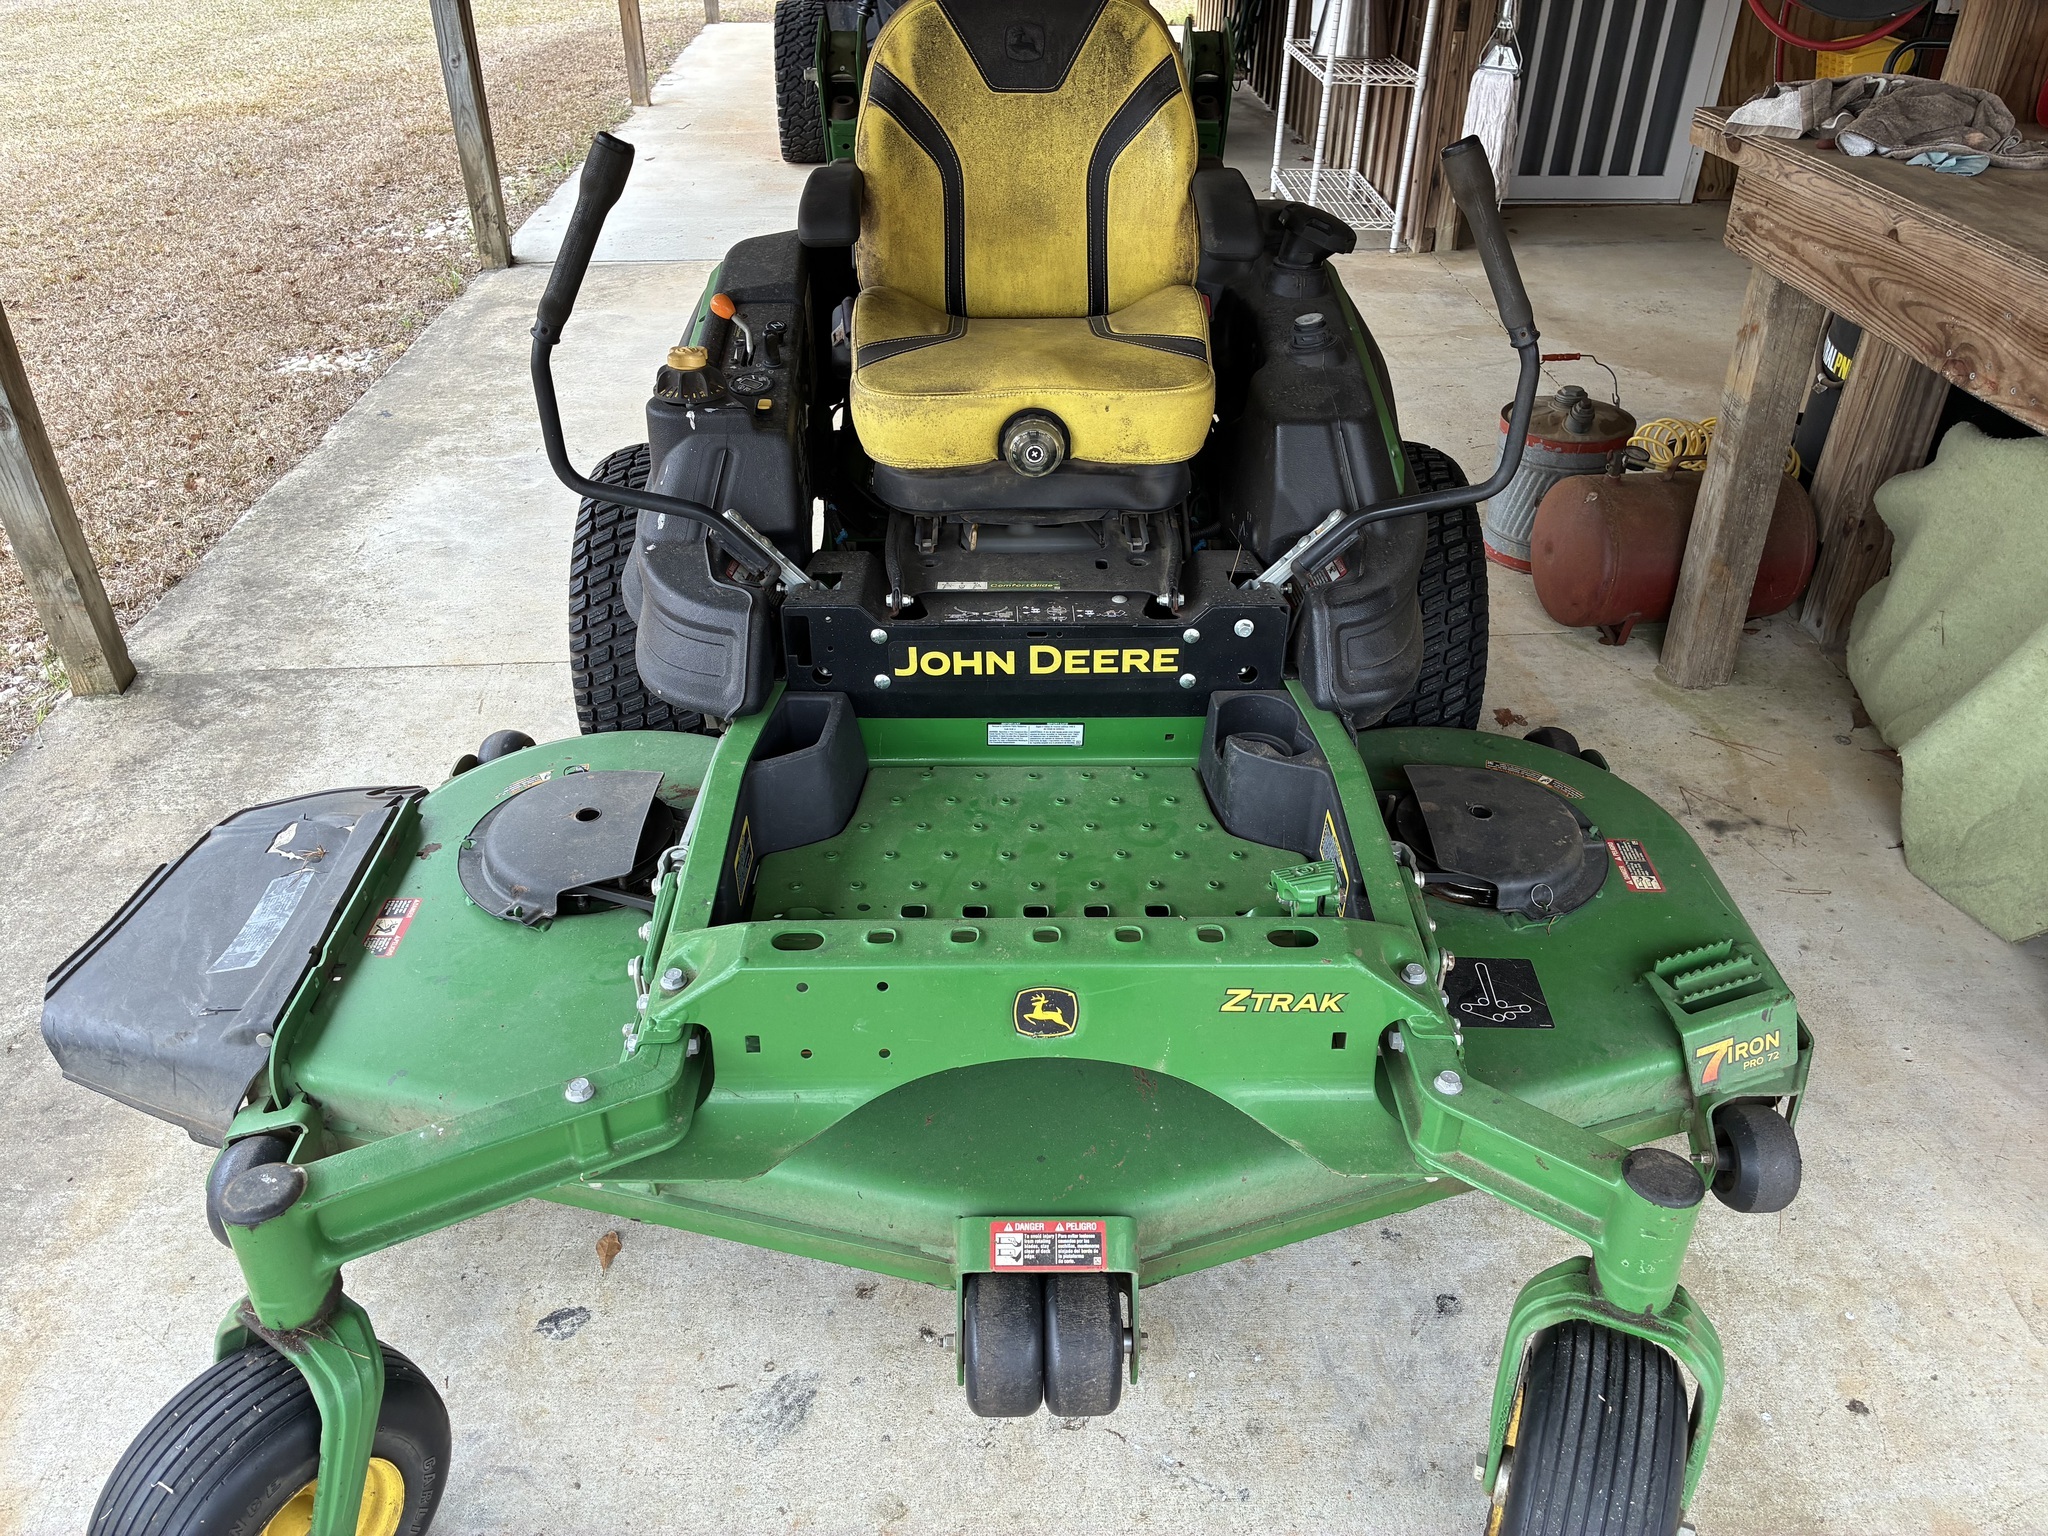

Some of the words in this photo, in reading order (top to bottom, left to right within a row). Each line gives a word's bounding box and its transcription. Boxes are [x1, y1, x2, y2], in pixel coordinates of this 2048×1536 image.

[894, 645, 1016, 677] JOHN
[1029, 644, 1179, 675] DEERE
[1219, 988, 1350, 1013] ZTRAK
[1743, 1056, 1764, 1071] PRO
[1767, 1050, 1780, 1063] 72
[1015, 1222, 1045, 1231] DANGER
[1065, 1222, 1097, 1231] PELIGRO
[412, 1455, 436, 1534] CARLI
